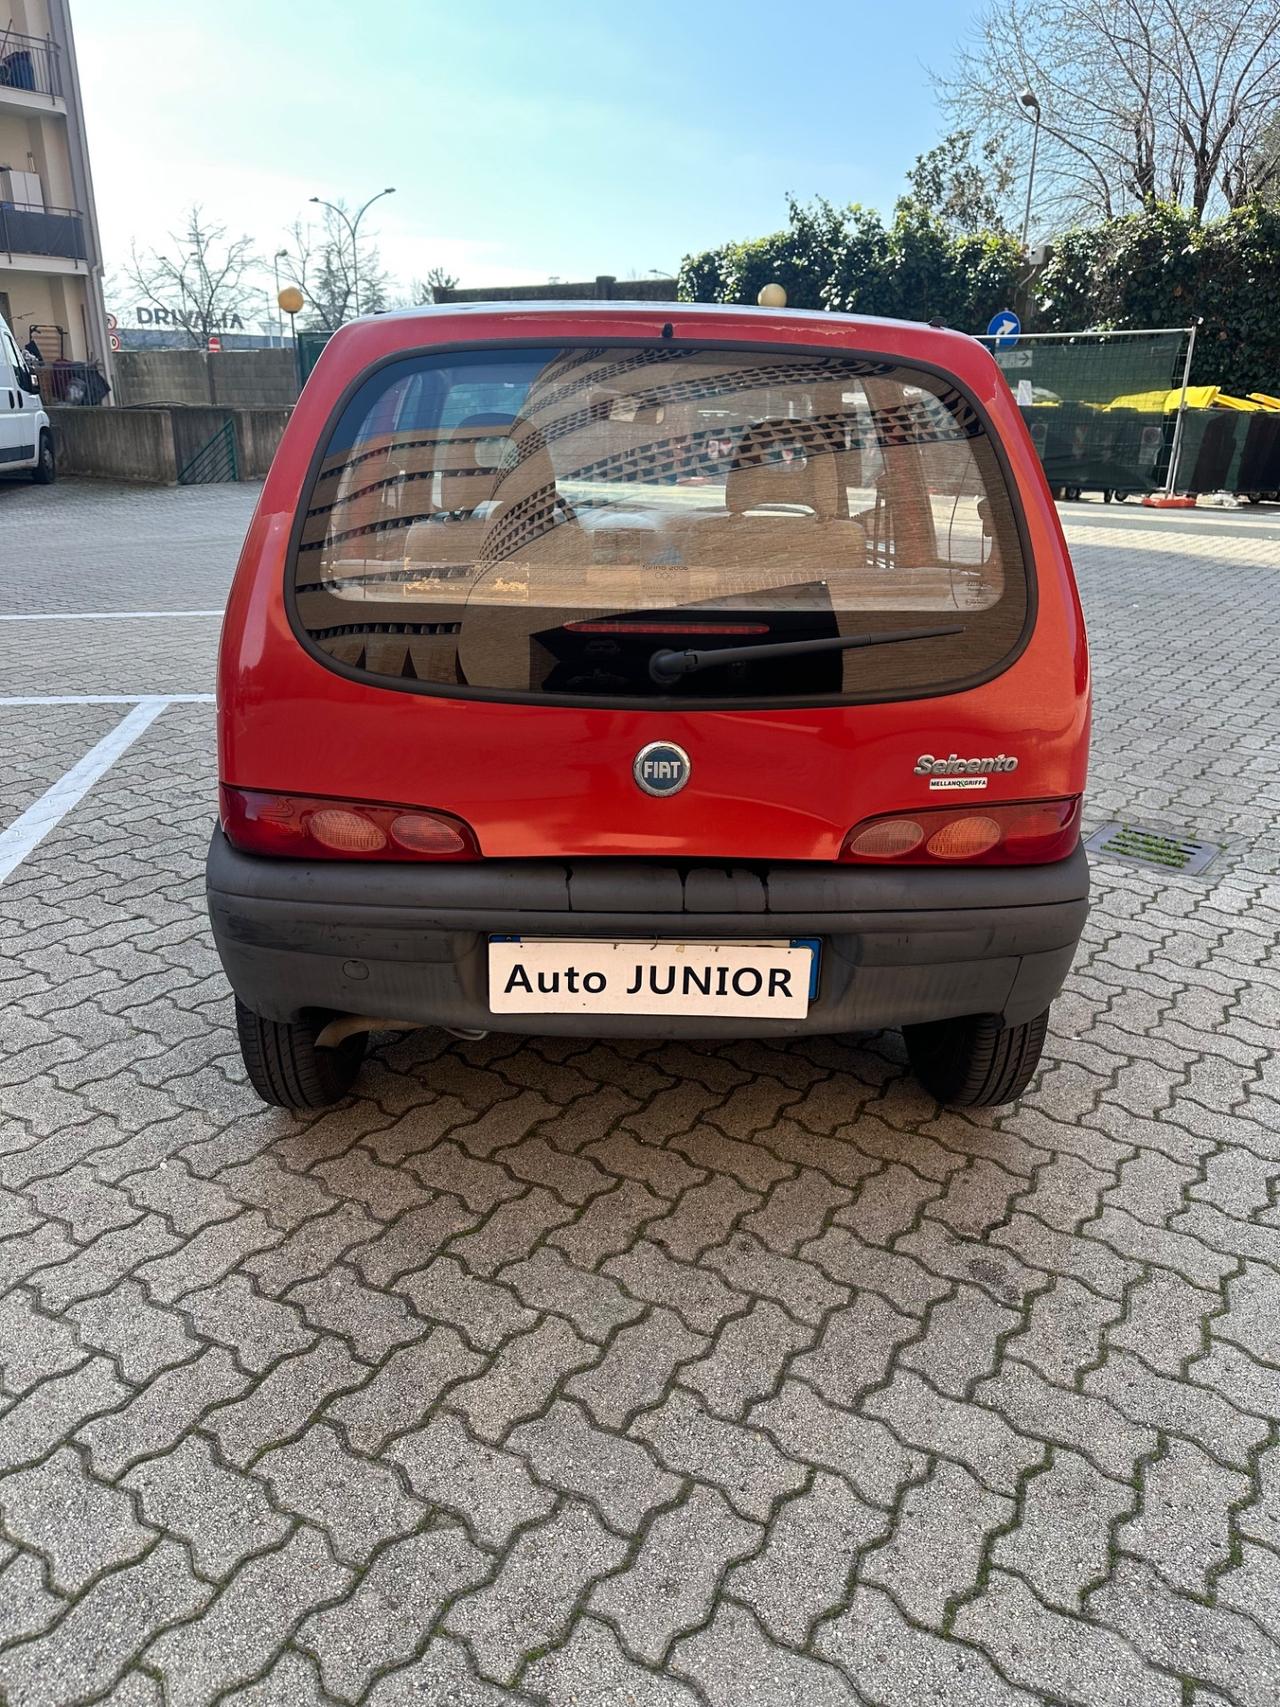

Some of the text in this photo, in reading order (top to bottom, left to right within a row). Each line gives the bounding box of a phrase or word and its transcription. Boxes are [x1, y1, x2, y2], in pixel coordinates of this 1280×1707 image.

[643, 761, 681, 779] FIAT
[914, 753, 1019, 775] Seicento
[504, 963, 793, 998] Auto JUNIOR
